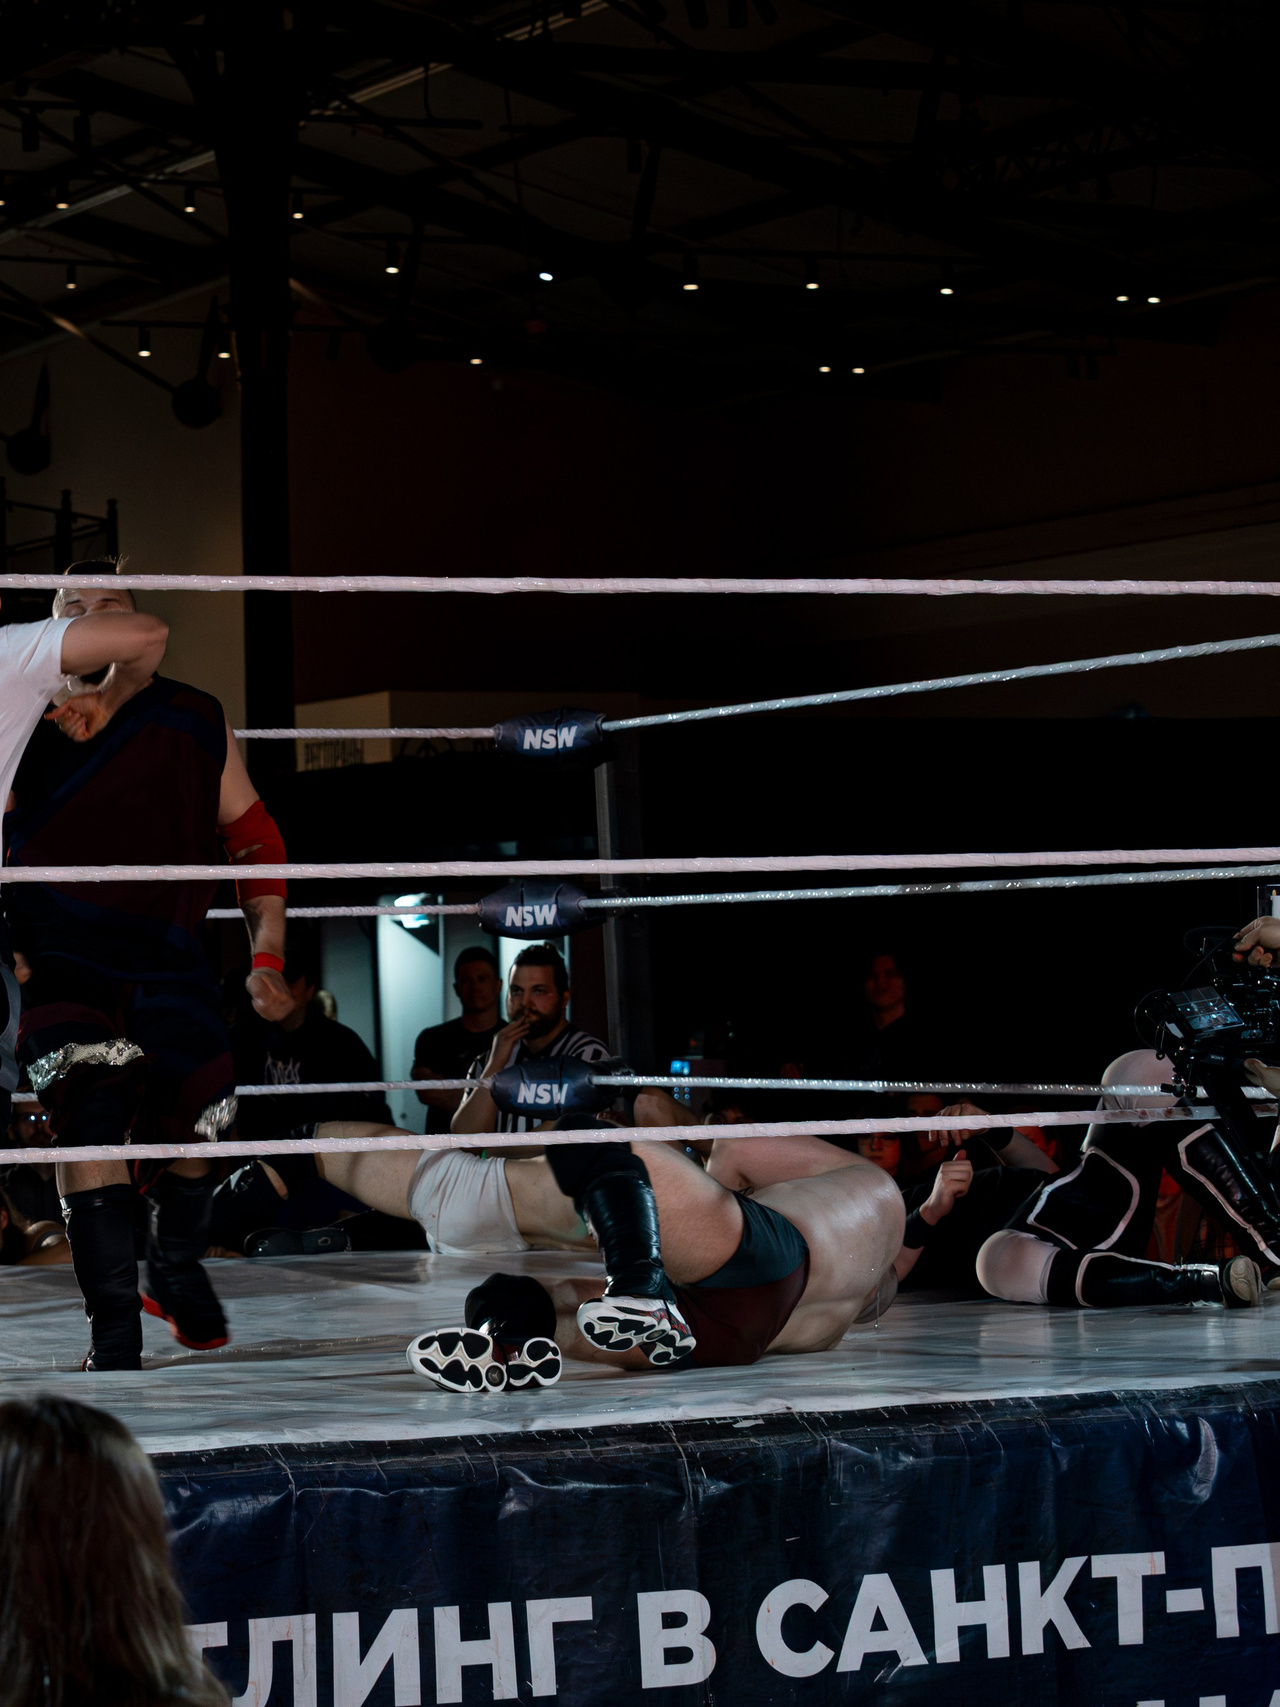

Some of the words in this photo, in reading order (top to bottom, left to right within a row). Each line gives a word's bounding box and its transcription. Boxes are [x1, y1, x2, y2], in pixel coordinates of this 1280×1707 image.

[523, 725, 577, 750] NSW
[504, 904, 557, 927] NSW
[637, 1589, 717, 1689] В
[755, 1541, 1280, 1679] САНКТ-П
